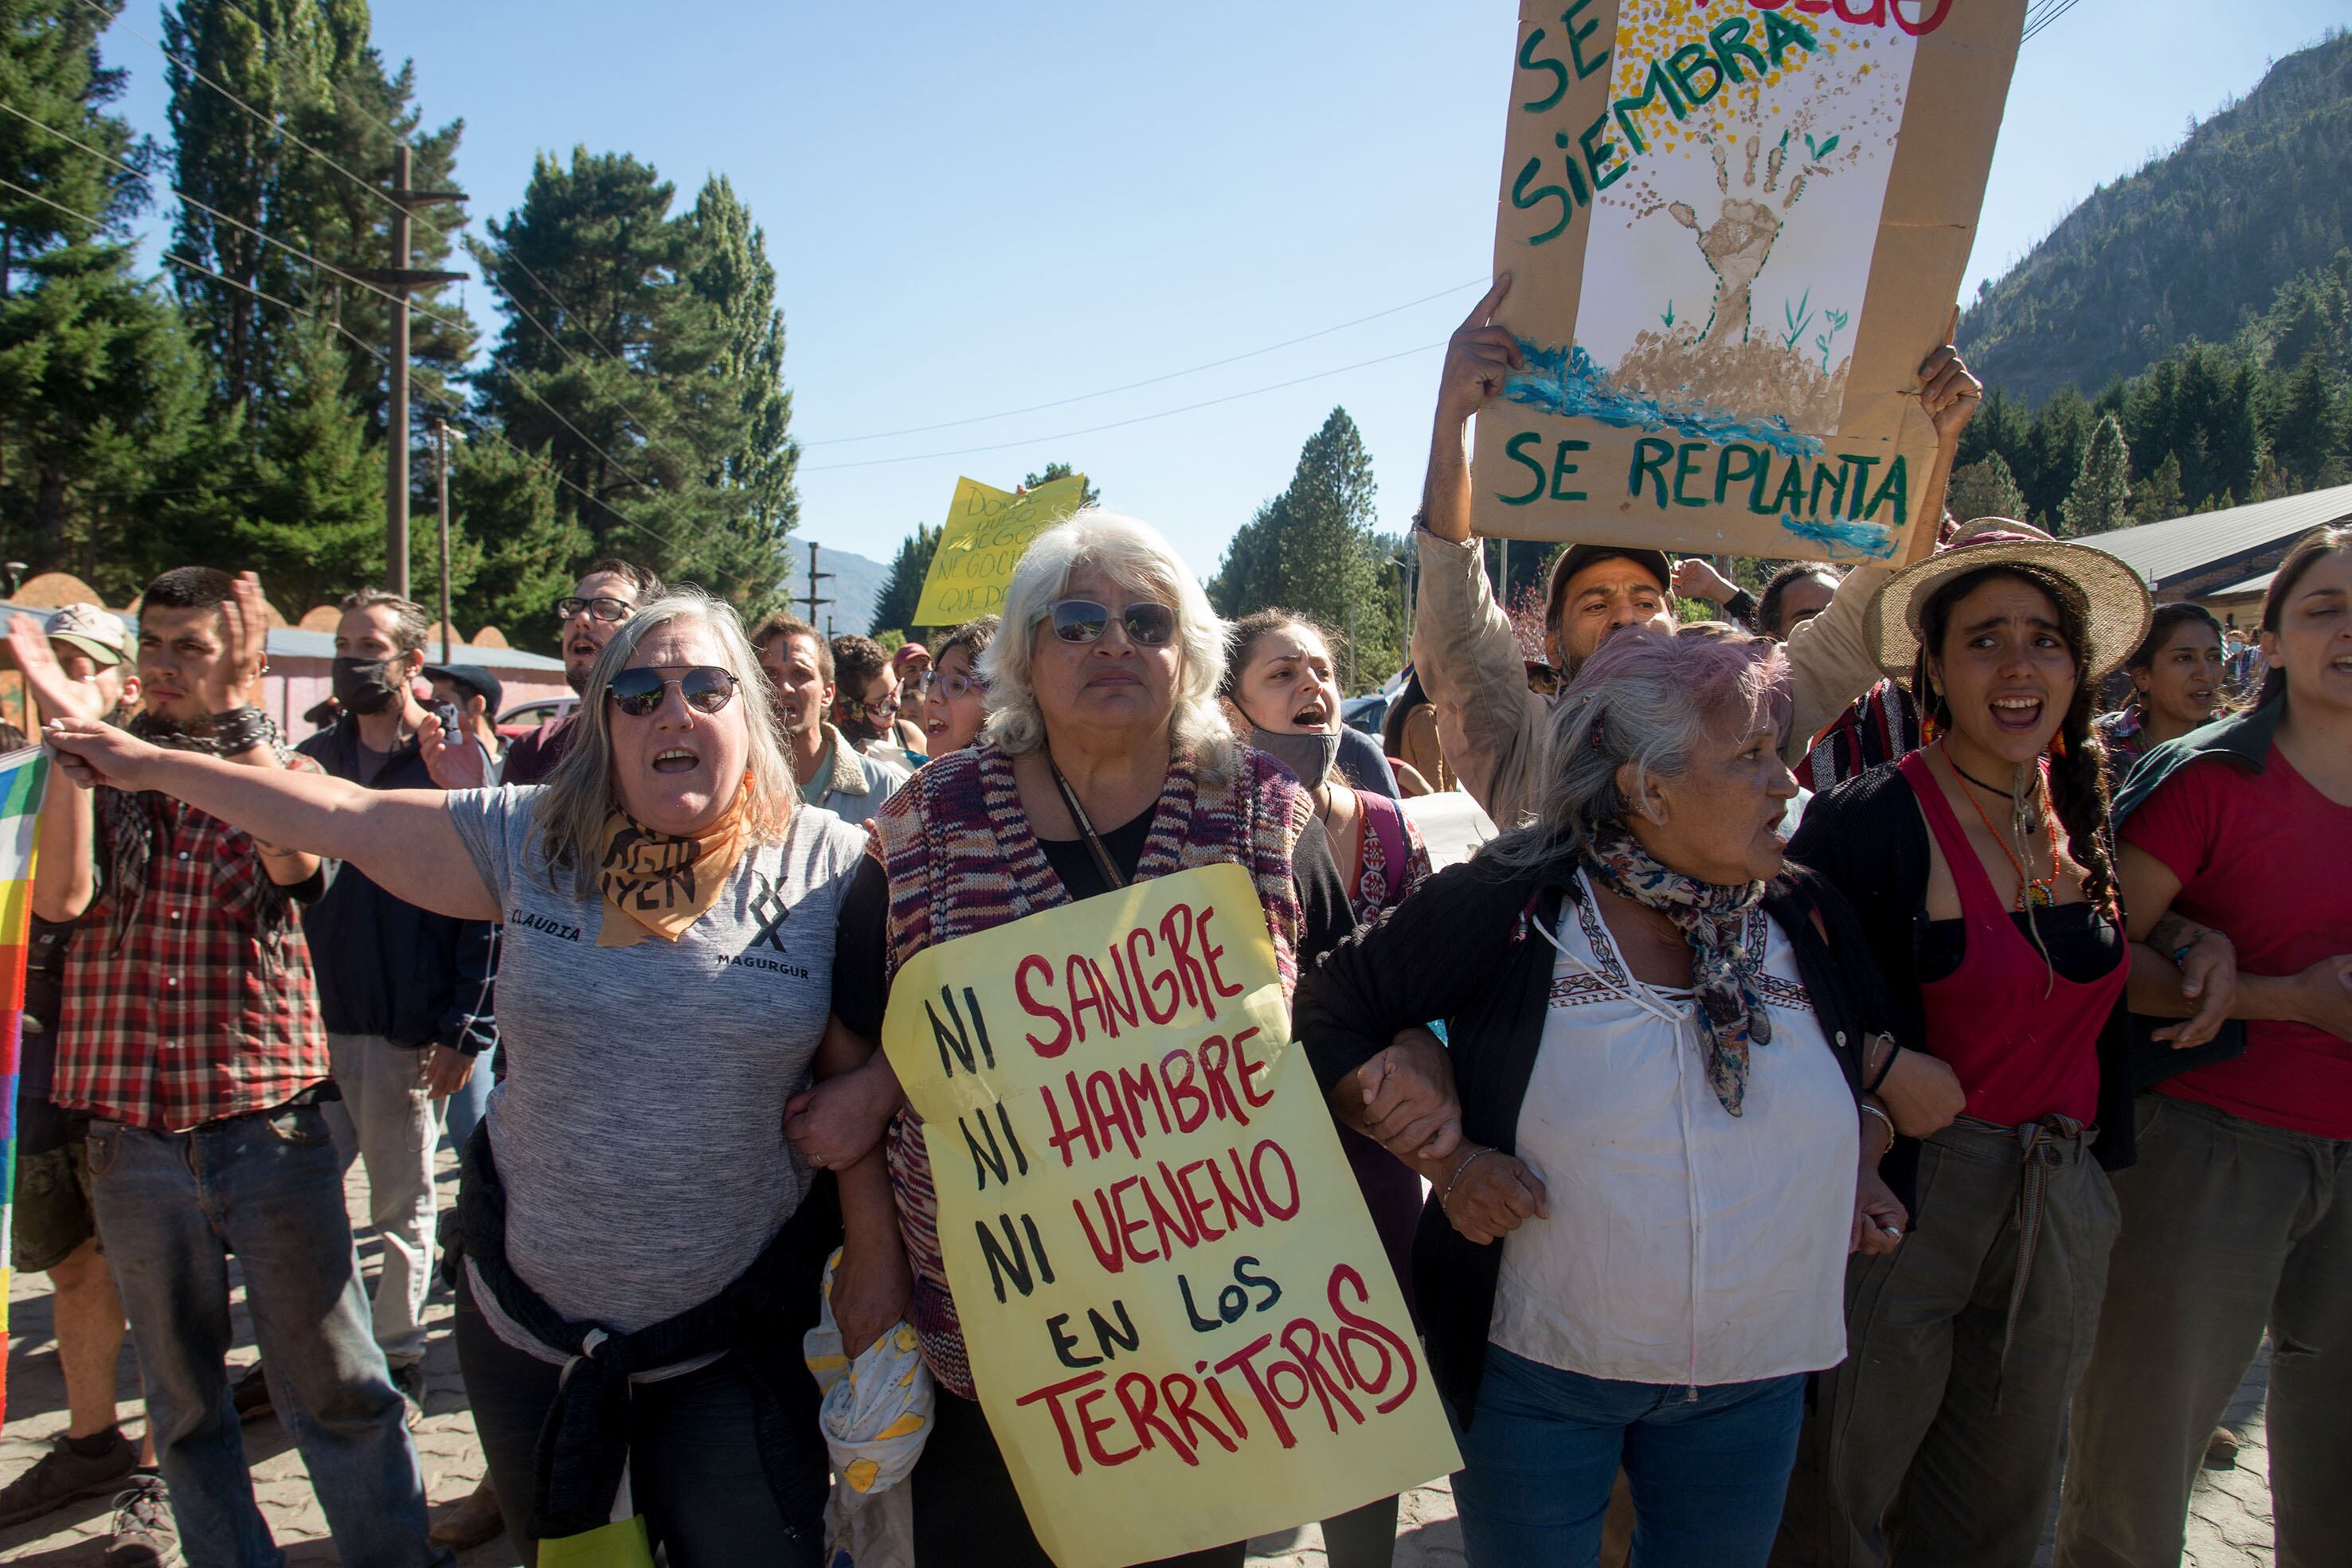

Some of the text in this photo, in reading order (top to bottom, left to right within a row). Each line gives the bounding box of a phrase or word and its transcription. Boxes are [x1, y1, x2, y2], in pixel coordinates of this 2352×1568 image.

[1518, 0, 1610, 112] SE
[1495, 432, 1908, 526] SE REPLANTA
[511, 909, 581, 942] CLAUDIA
[718, 955, 809, 980] MAGURGUR
[920, 903, 1244, 1079] NI SANGRE
[958, 1026, 1274, 1191] NI HAMBRE
[975, 1139, 1300, 1304] NI VENENO
[1046, 1300, 1140, 1368] EN
